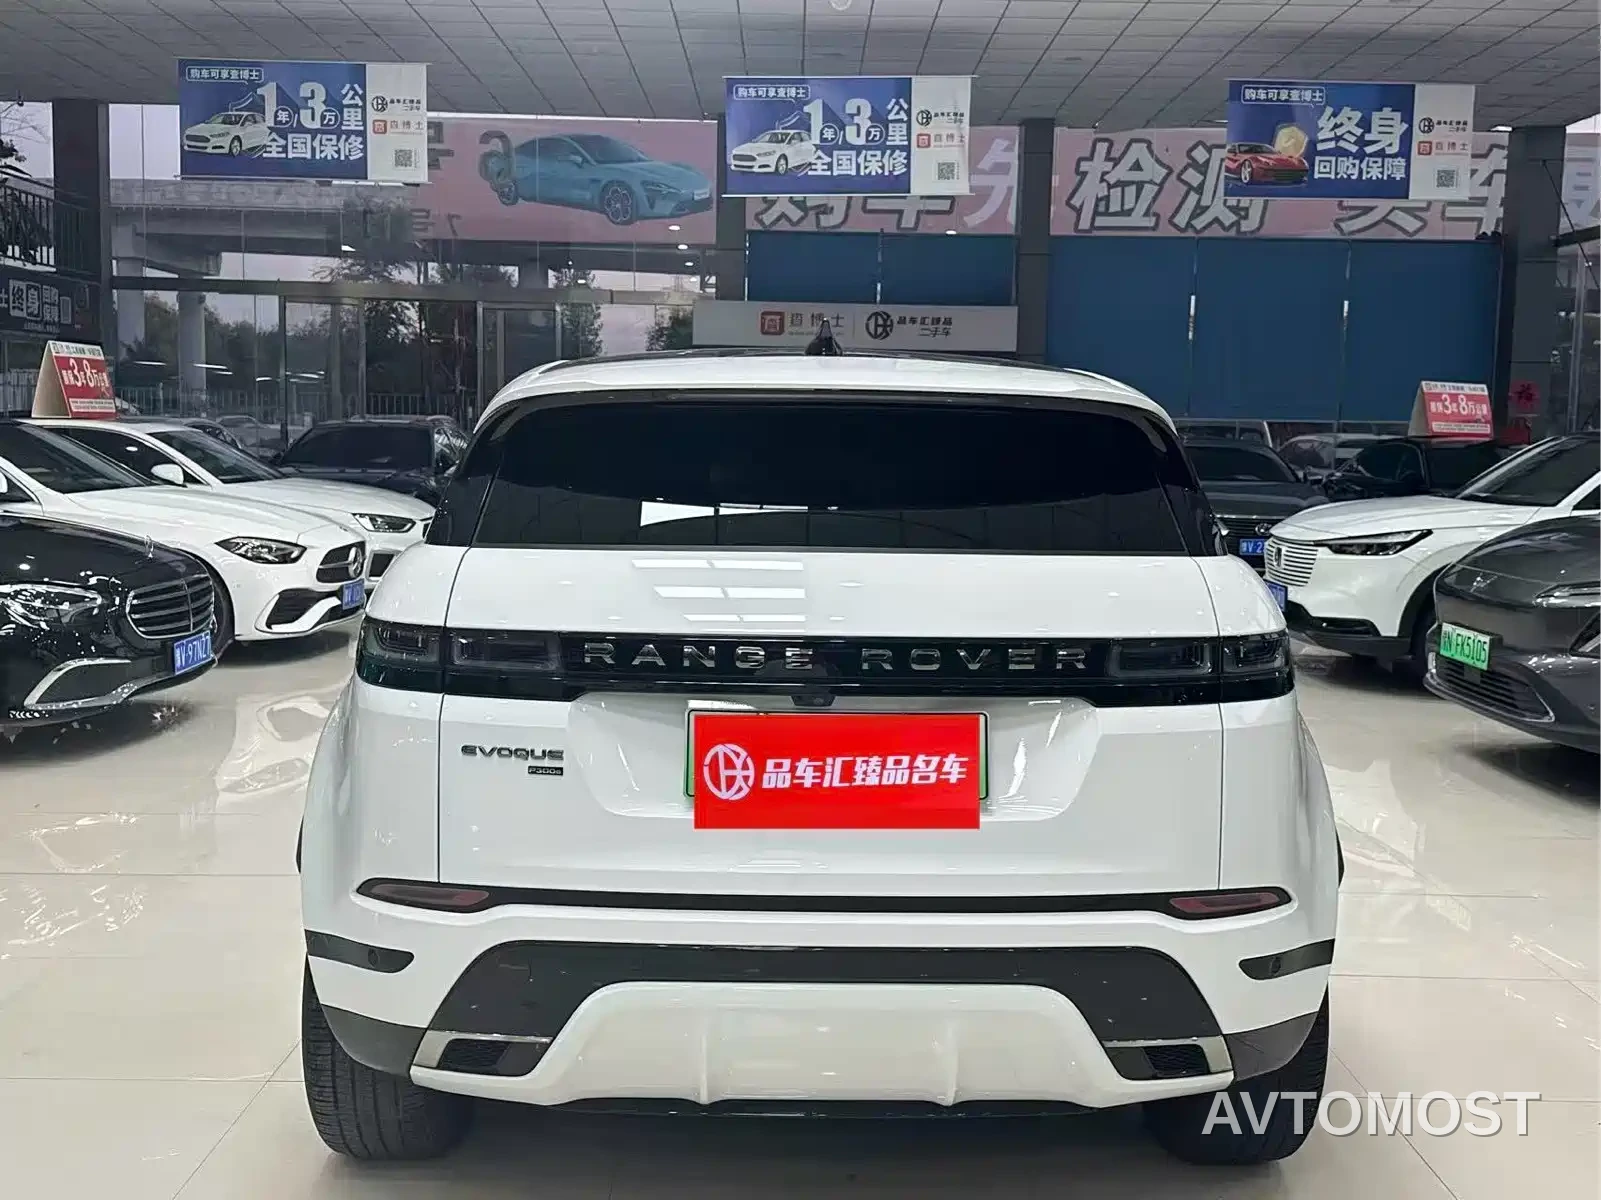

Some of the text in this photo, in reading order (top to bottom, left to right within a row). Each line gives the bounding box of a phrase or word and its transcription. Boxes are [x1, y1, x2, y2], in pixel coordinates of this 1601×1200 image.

[189, 68, 260, 81] 购车可享查博士
[737, 86, 807, 98] 购车可享查博士
[1244, 88, 1324, 102] 购车可享查博士
[1316, 106, 1409, 154] 终身
[262, 133, 364, 160] 全国保修
[807, 149, 909, 176] 全国保修
[1314, 156, 1406, 181] 回购保障
[584, 642, 1088, 671] RANGE ROVER
[461, 744, 564, 761] EVOQUE
